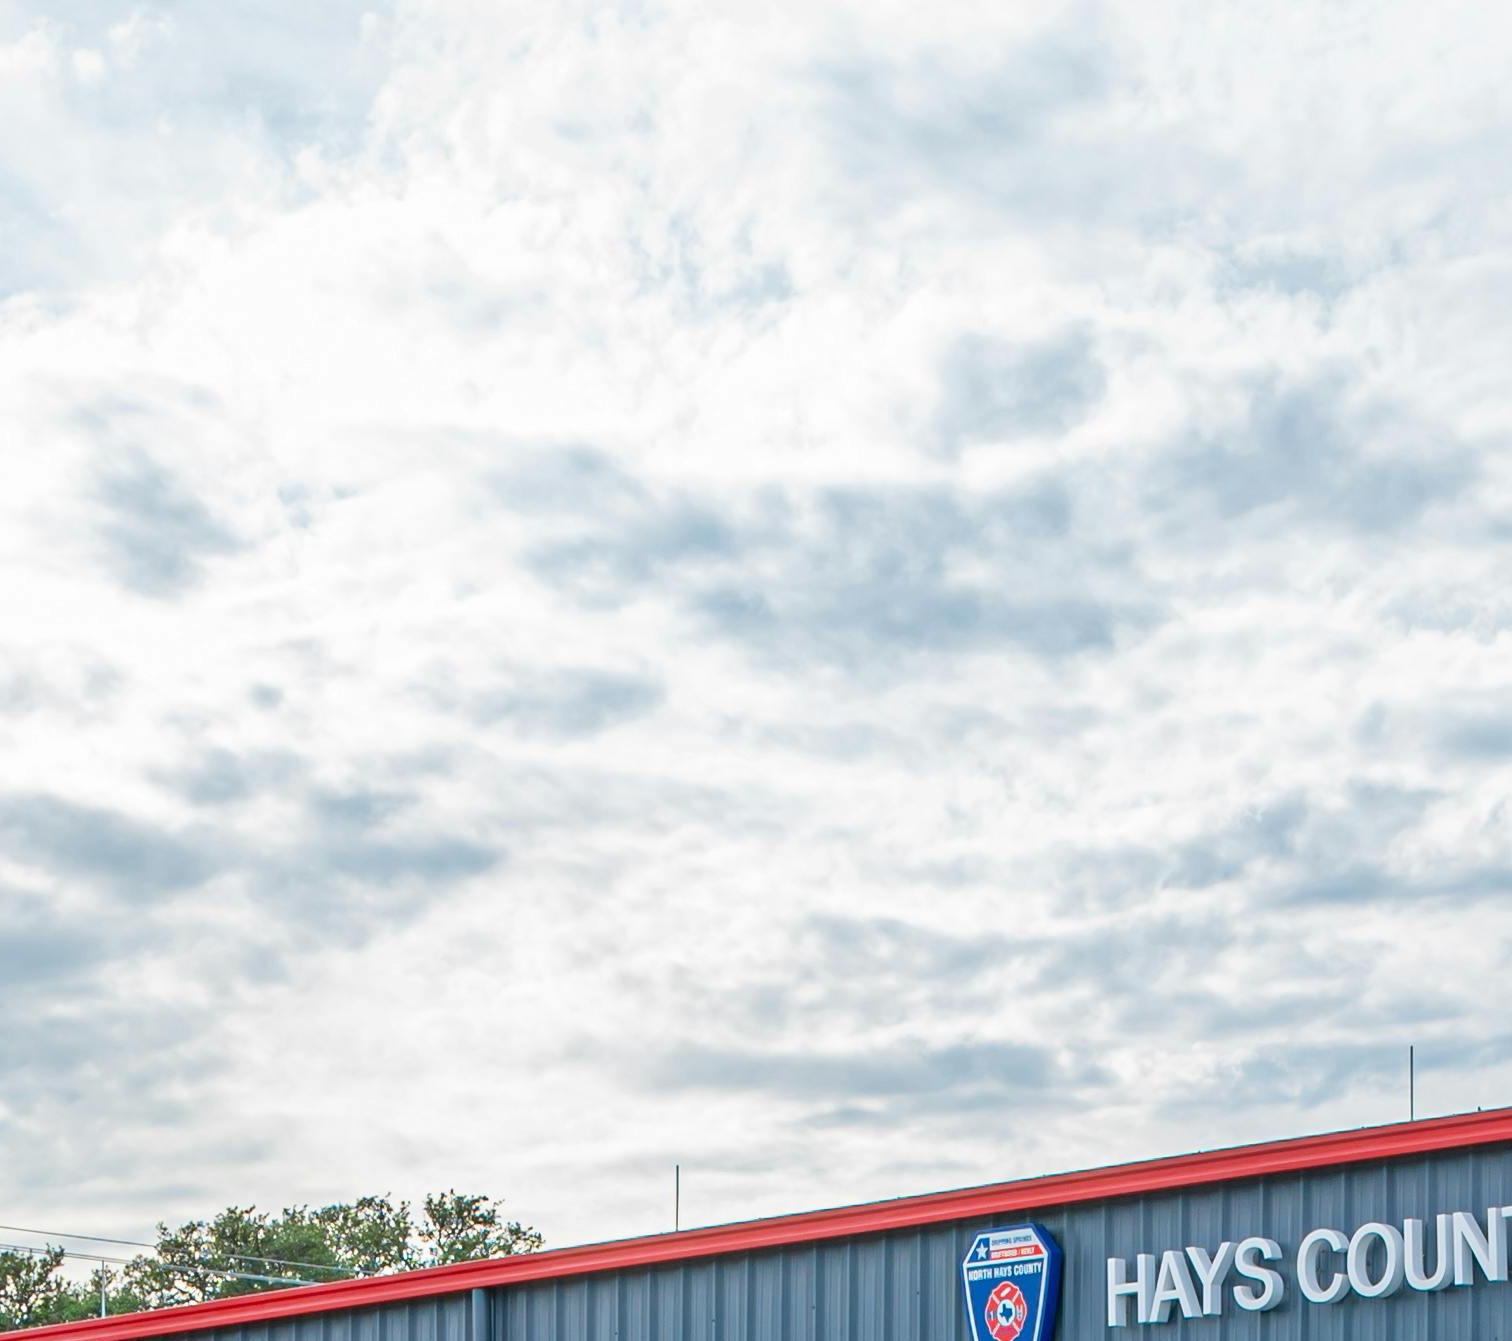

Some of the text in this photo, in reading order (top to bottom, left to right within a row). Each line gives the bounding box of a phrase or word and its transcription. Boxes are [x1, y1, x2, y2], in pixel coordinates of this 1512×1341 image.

[968, 1262, 1042, 1281] NORTH HAYS COUNTY
[1107, 1237, 1284, 1327] HAYS
